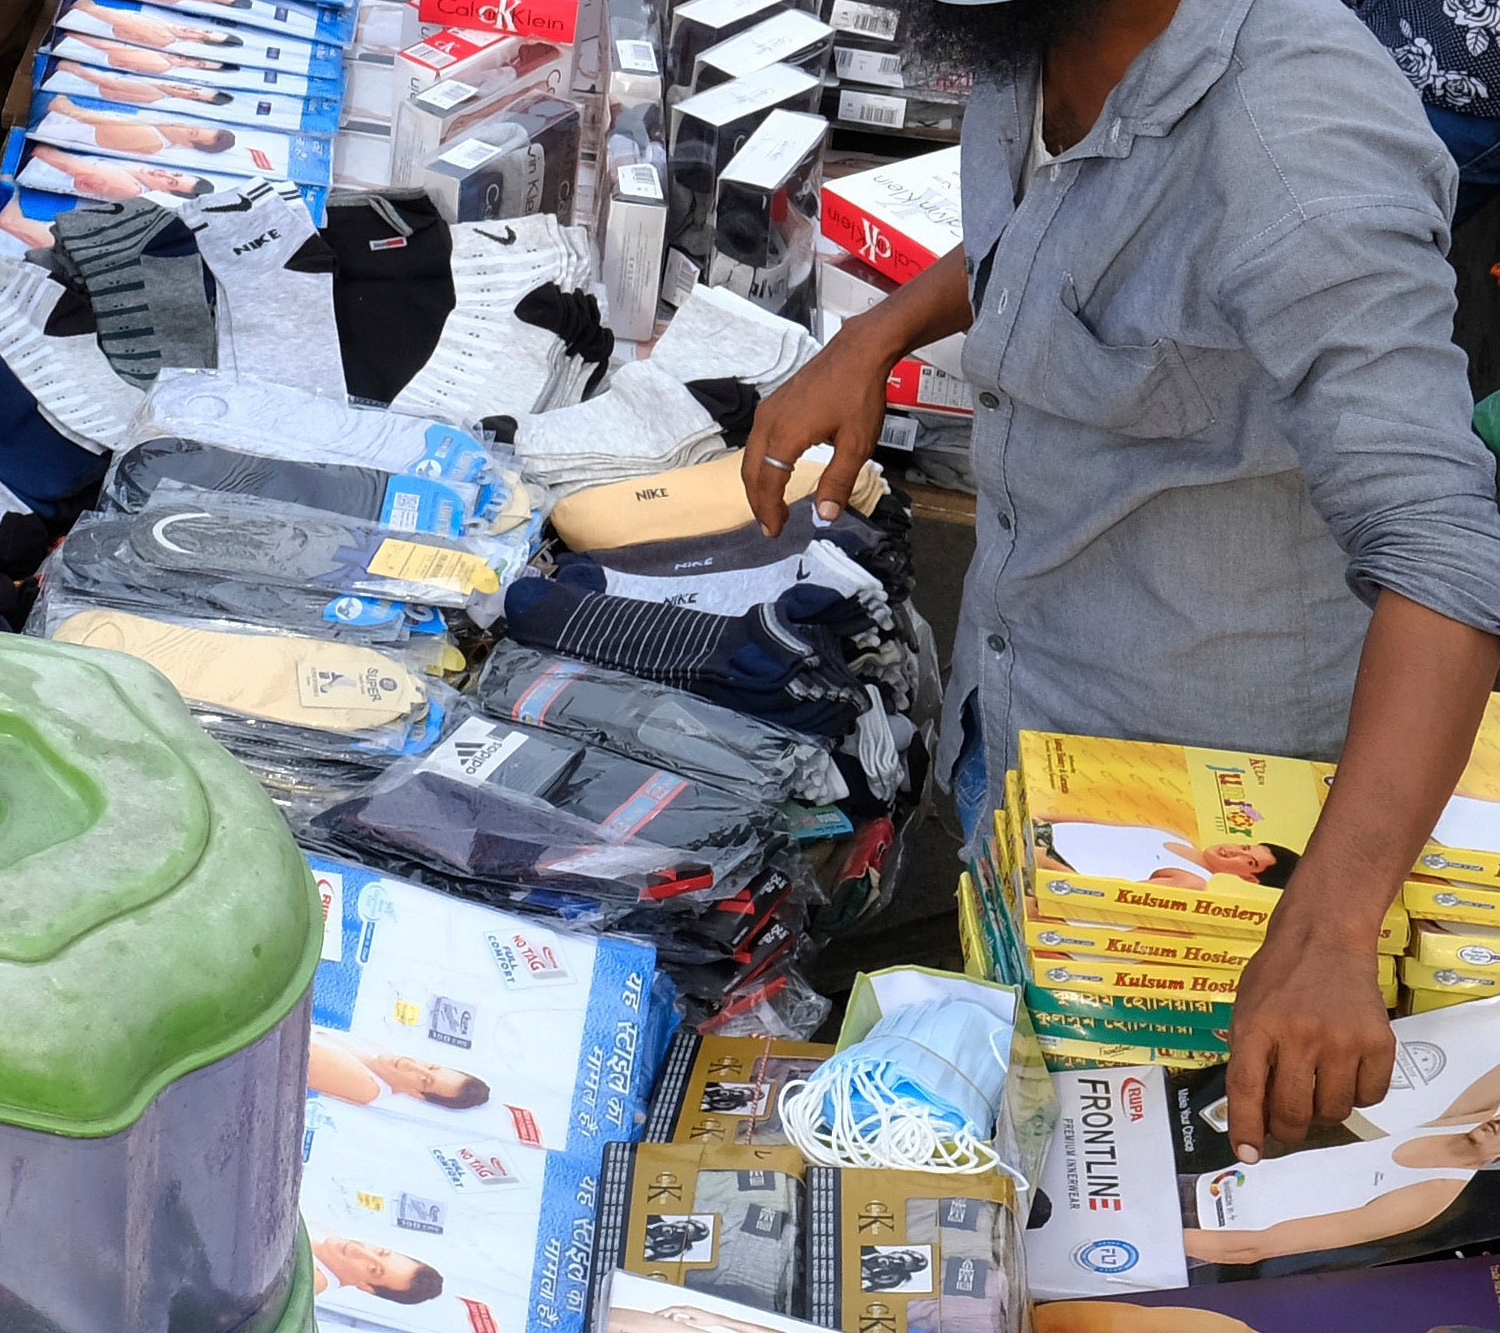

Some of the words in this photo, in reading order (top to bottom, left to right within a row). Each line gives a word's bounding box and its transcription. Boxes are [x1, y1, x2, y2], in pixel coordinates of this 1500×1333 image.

[511, 9, 565, 31] Klein
[231, 227, 283, 257] NIKE
[634, 486, 671, 503] NIKE
[366, 666, 383, 703] SUPER
[464, 739, 503, 776] adidas
[1113, 889, 1189, 914] Kulsum
[1191, 900, 1269, 926] Hosiery
[487, 935, 516, 984] COMFORT
[500, 945, 518, 970] FULL
[512, 934, 527, 949] NO
[521, 946, 545, 972] TAG
[1104, 939, 1179, 960] Kulsum
[623, 973, 644, 1013] यह
[1114, 972, 1187, 992] Kulsum
[607, 1020, 638, 1095] स्टाइल
[605, 1097, 625, 1131] का
[1128, 1086, 1145, 1123] RUPA
[1063, 1118, 1077, 1159] PREMIUM
[1077, 1077, 1123, 1212] FRONTLINE
[470, 1156, 495, 1180] TAG
[1067, 1159, 1081, 1210] INNERWEAR
[577, 1173, 597, 1210] यह
[565, 1284, 584, 1314] का
